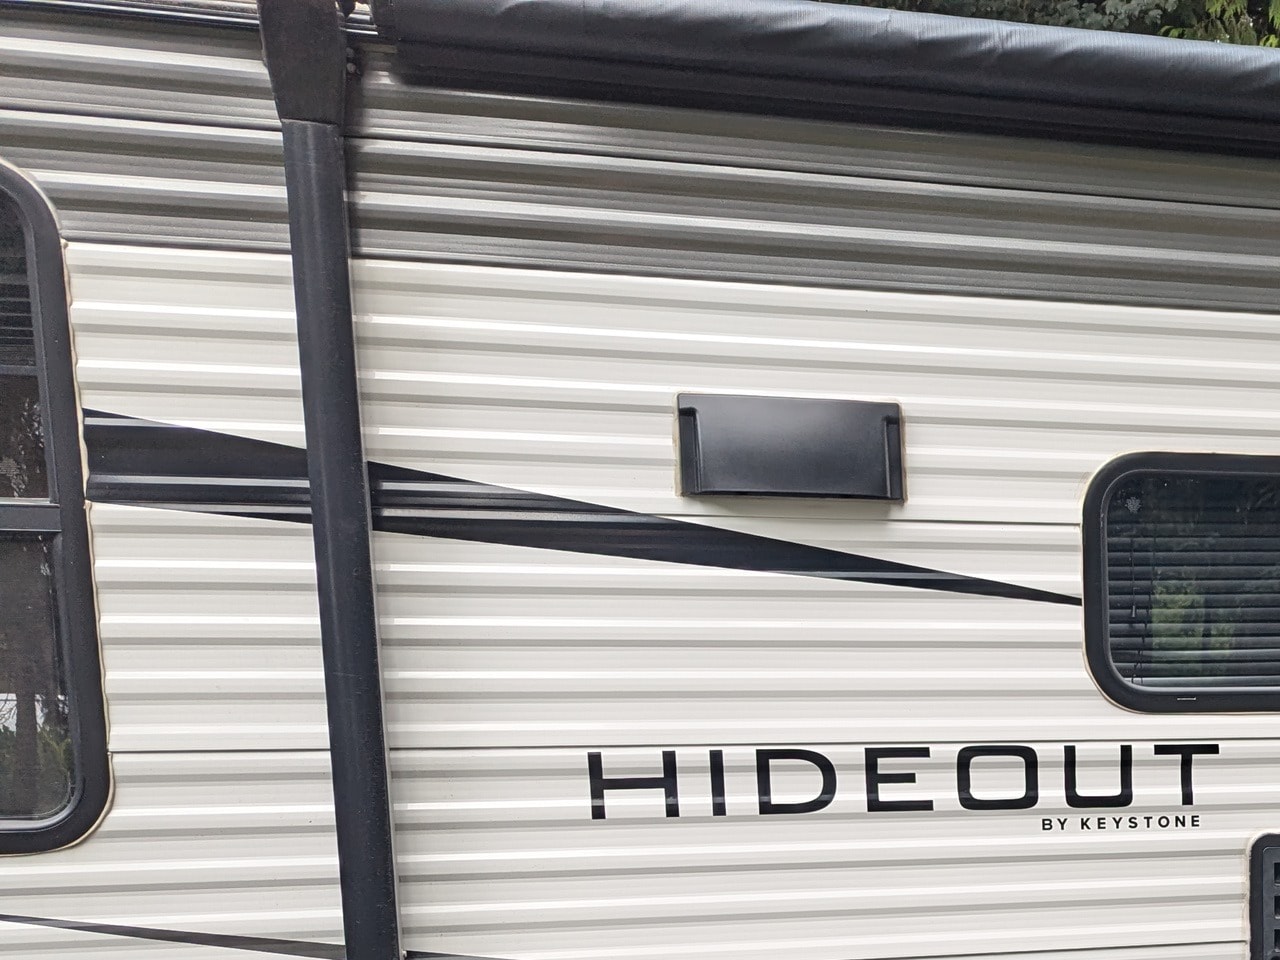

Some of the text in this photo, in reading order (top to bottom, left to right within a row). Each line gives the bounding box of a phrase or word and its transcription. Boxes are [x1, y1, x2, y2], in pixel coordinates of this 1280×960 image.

[587, 744, 1220, 819] HIDEOUT
[1041, 815, 1201, 831] BY KEYSTONE
